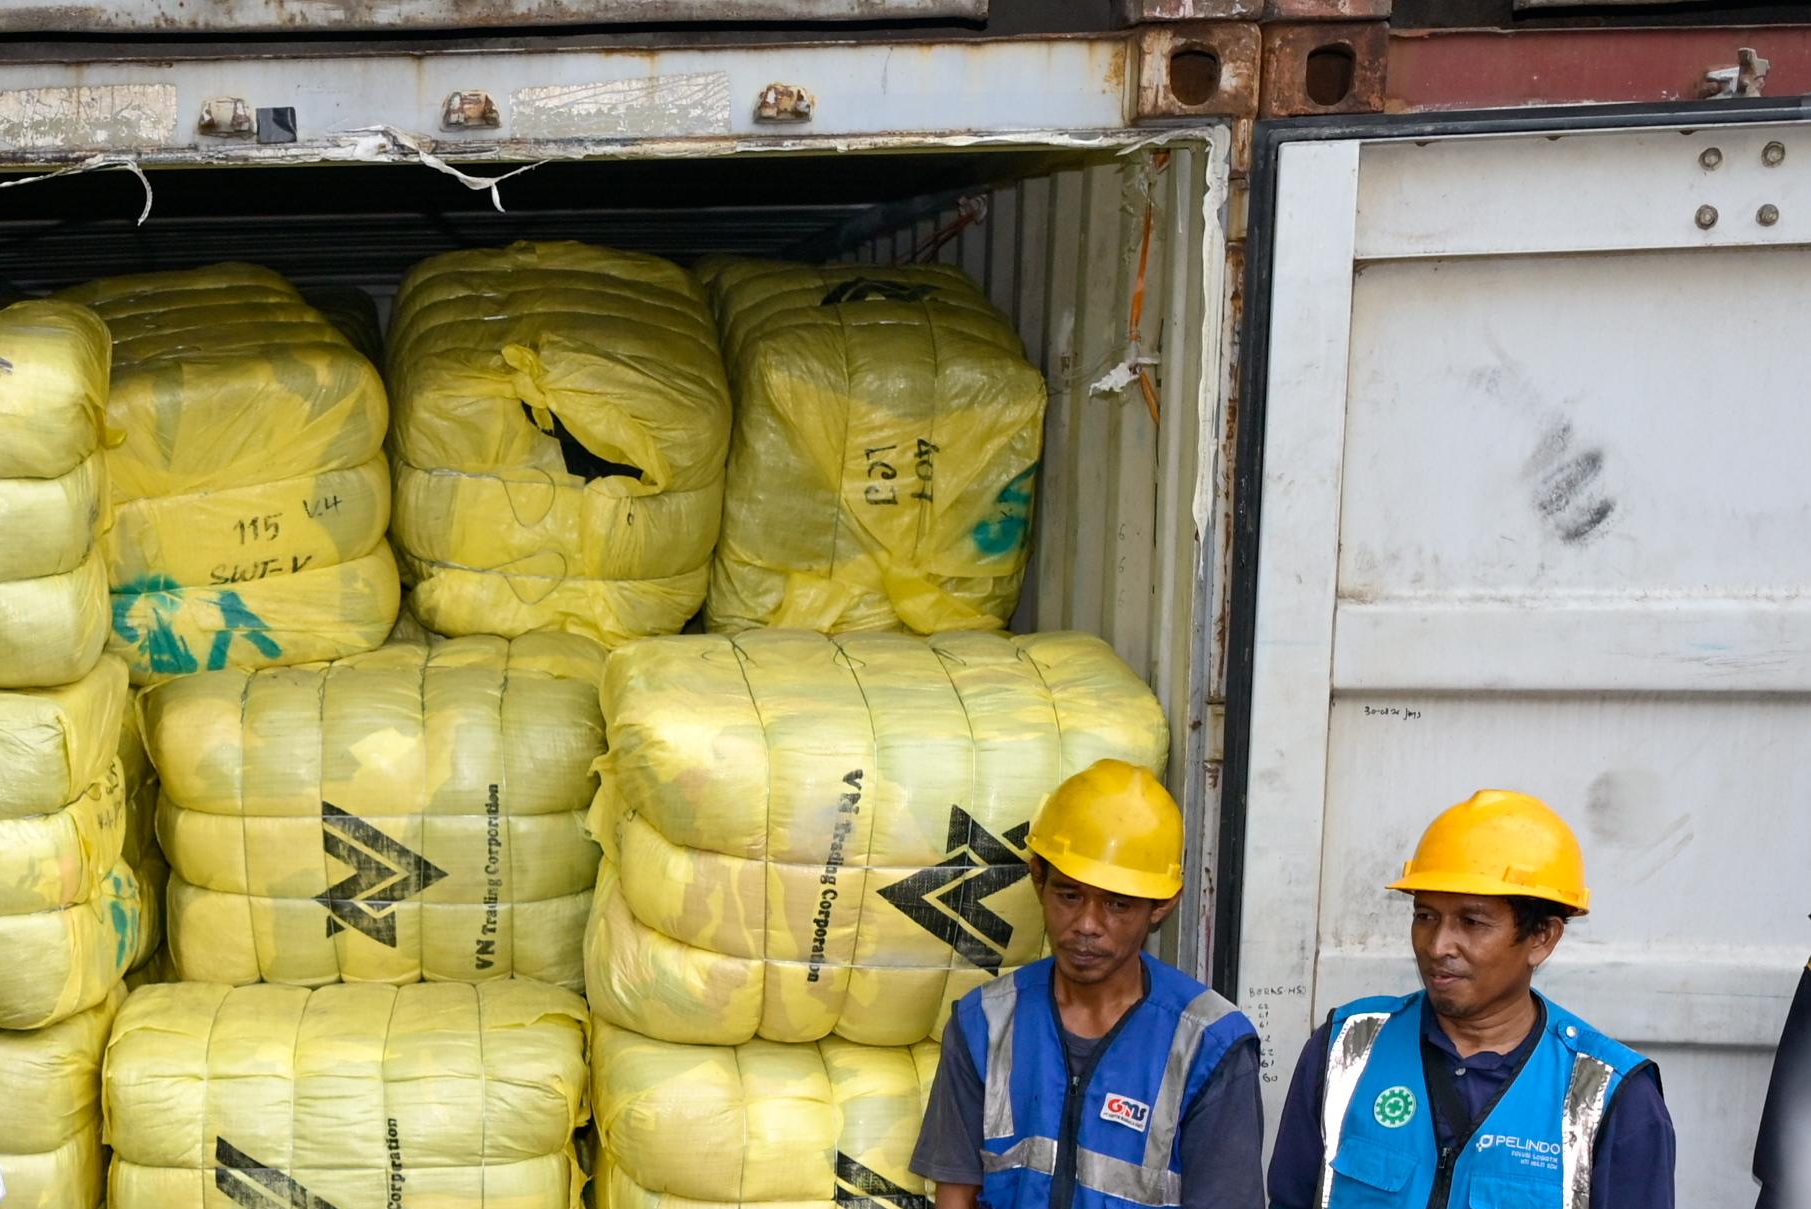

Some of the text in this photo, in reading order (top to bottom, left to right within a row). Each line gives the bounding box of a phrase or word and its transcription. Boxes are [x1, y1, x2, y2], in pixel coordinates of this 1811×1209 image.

[233, 513, 283, 545] 115
[475, 938, 496, 970] VN
[1495, 1135, 1561, 1155] PELINDO
